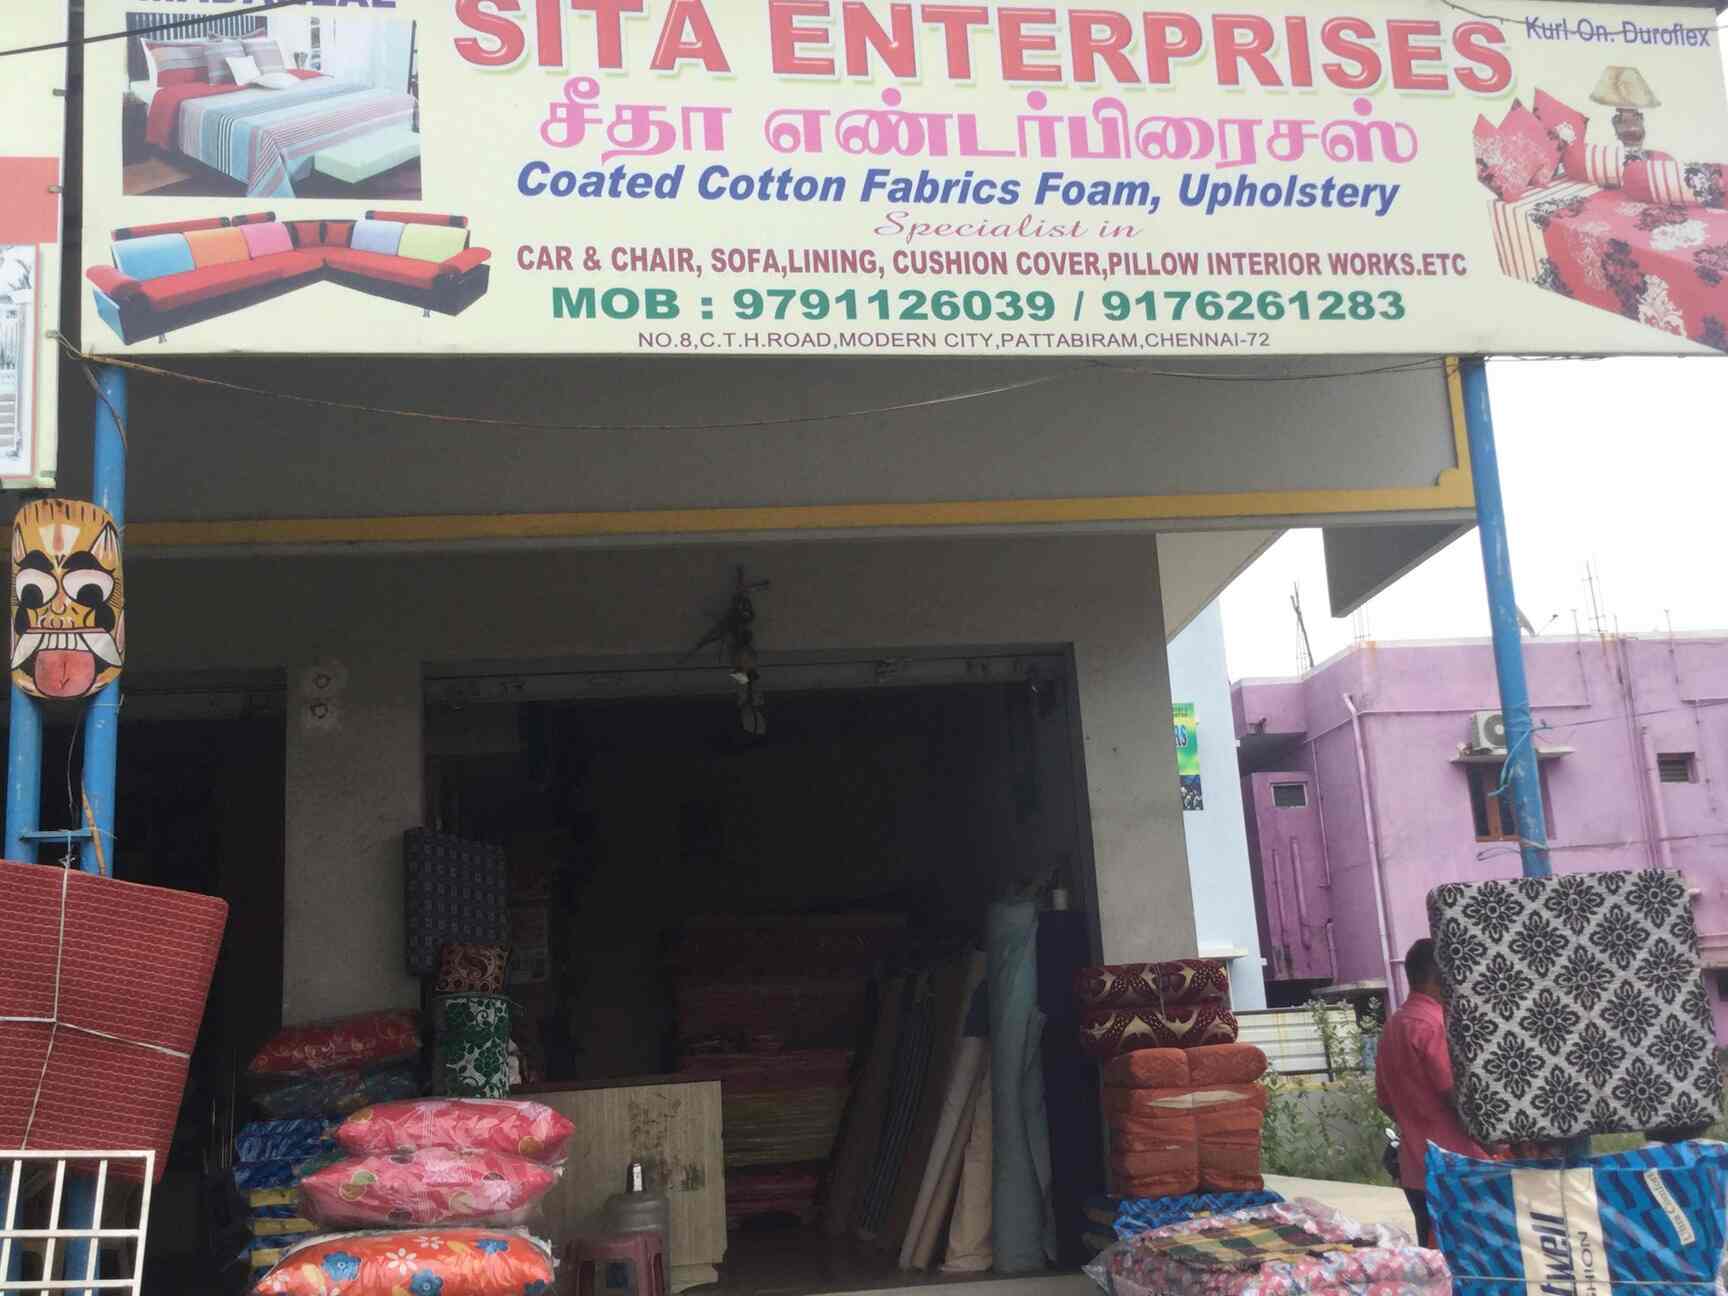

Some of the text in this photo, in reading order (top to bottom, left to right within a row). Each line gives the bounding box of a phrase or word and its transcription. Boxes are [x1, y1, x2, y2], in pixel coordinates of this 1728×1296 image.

[455, 0, 1512, 93] SITA ENTERPRISES
[1525, 16, 1568, 40] Kurl
[1622, 20, 1711, 47] Duroflex
[540, 76, 1418, 169] சீதா எண்டர்பிரைசஸ்
[517, 160, 1400, 217] Coated Cotton Fabrics Foam, Upholstery
[874, 212, 1142, 244] Specialist in
[517, 245, 573, 271] CAR
[583, 246, 602, 271] &
[611, 247, 702, 278] CHAIR,
[893, 250, 1008, 275] CUSHION
[1207, 252, 1322, 276] INTERIOR
[552, 287, 680, 320] MOB
[733, 288, 1055, 322] 9791126039
[1074, 291, 1084, 321] /
[1102, 290, 1405, 321] 9176261283
